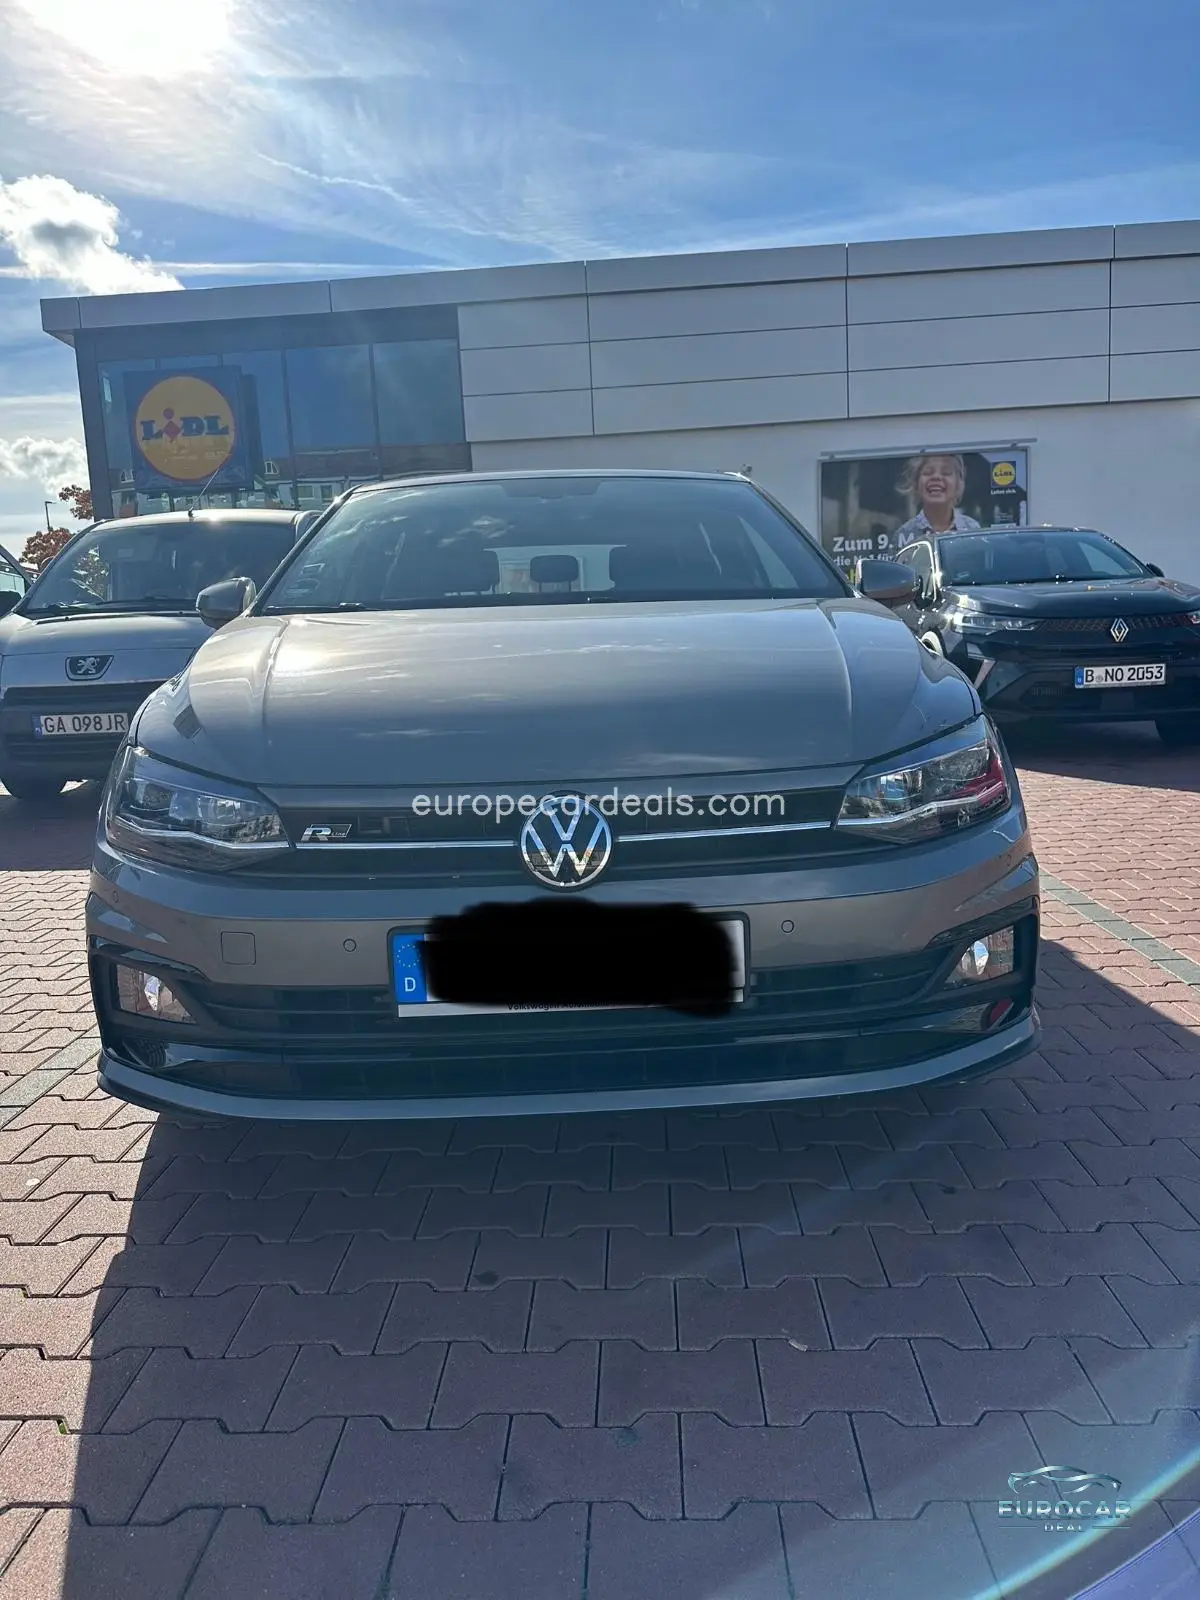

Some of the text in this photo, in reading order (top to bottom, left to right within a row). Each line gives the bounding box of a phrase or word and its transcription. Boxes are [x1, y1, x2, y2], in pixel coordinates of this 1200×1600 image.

[140, 407, 230, 442] LIDL
[833, 536, 872, 552] Zum
[877, 533, 893, 550] 9.
[833, 555, 851, 566] die
[1085, 669, 1094, 683] B
[1104, 668, 1124, 682] NO
[1127, 665, 1163, 681] 2053
[44, 717, 67, 733] GA
[301, 827, 332, 841] R
[404, 977, 416, 992] D
